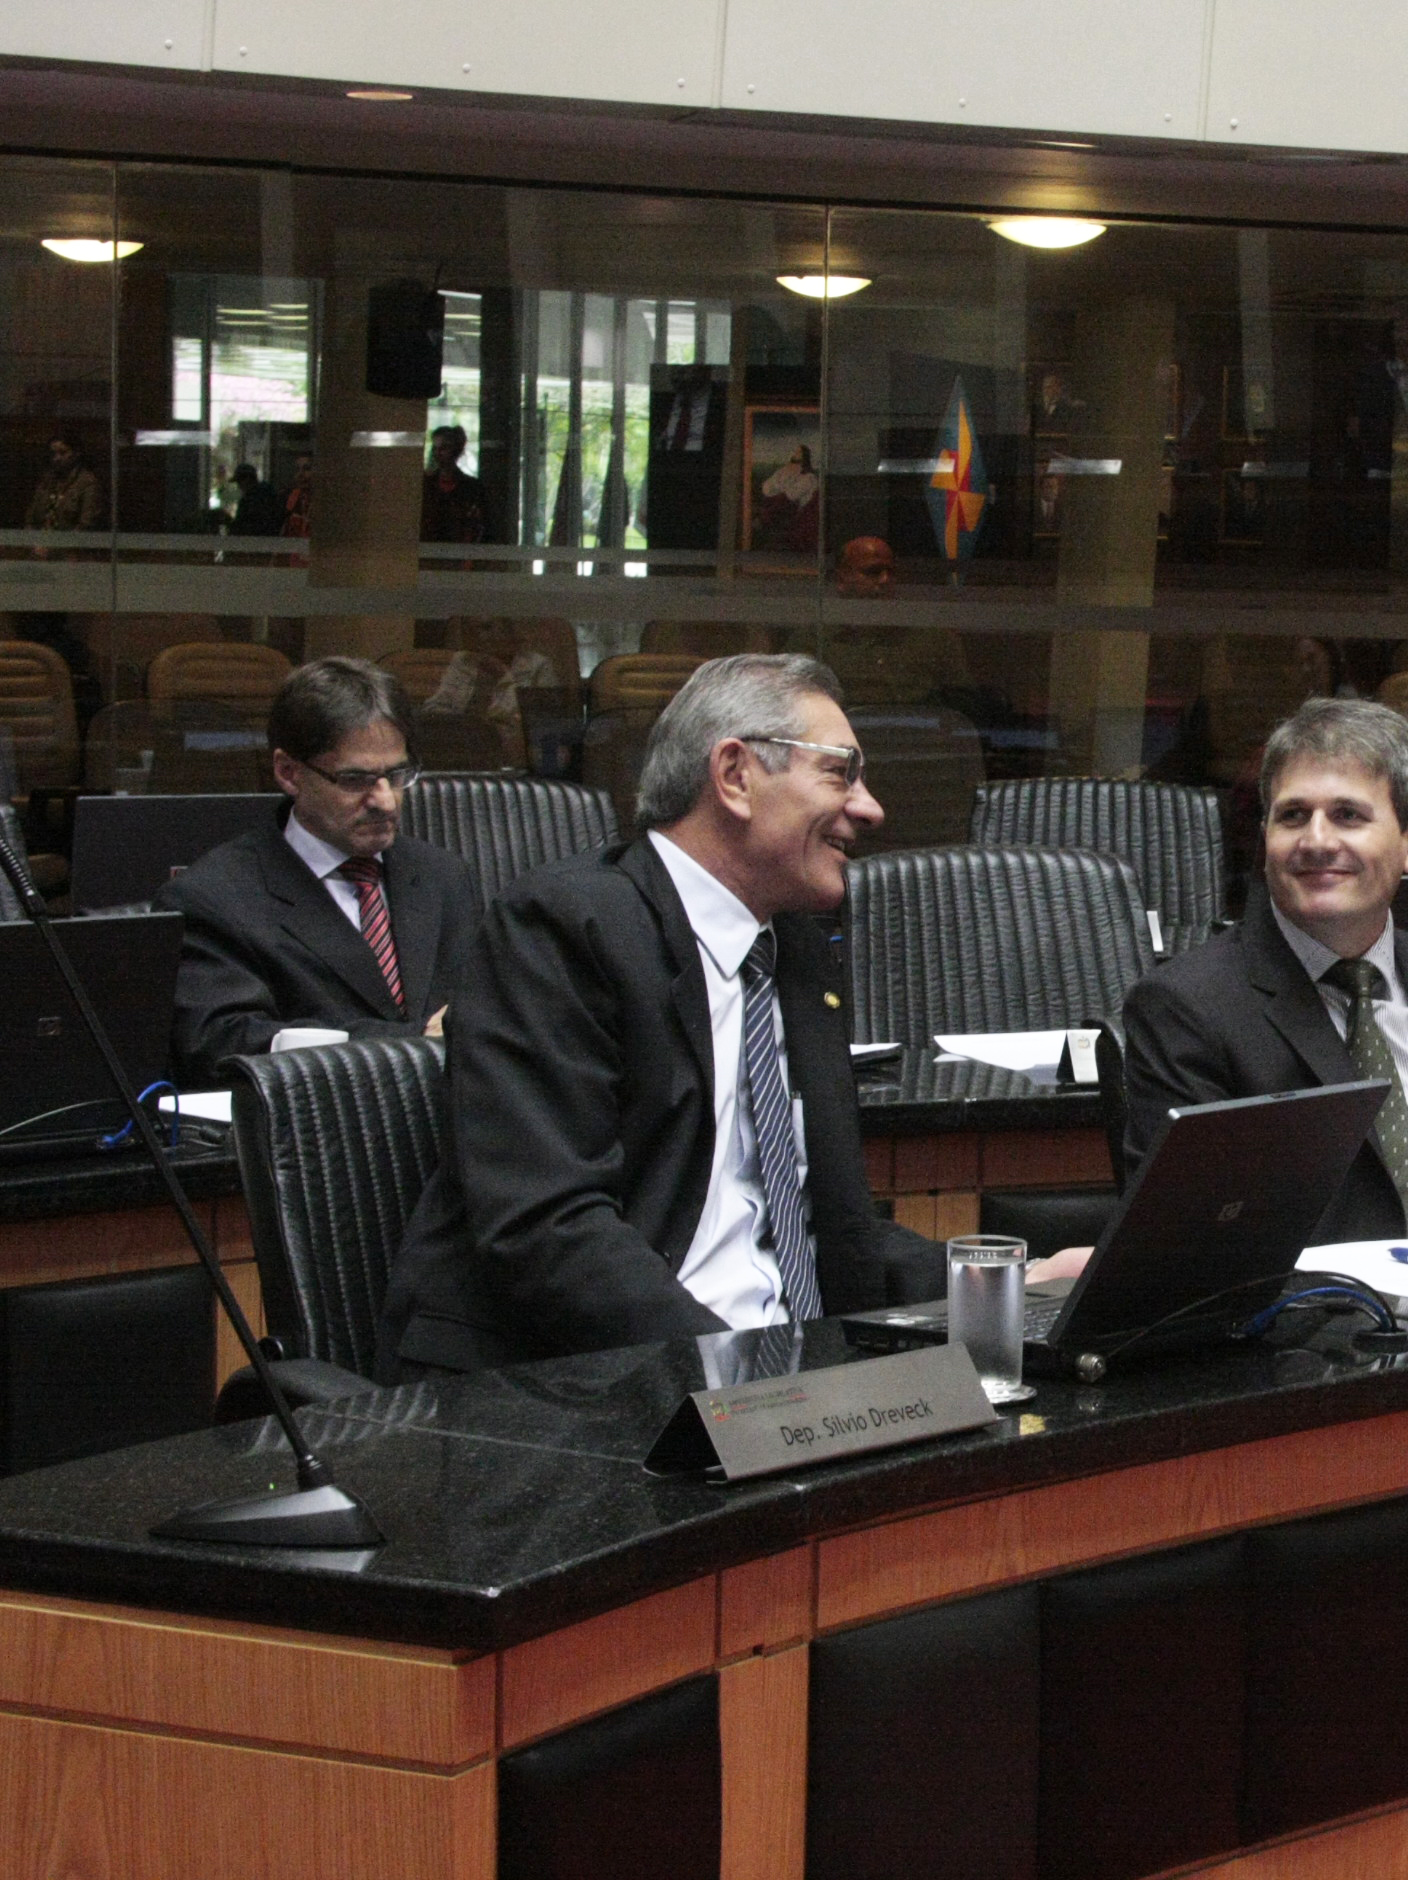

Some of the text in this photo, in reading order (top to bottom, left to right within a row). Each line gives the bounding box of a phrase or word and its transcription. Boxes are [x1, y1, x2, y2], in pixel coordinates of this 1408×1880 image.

[780, 1398, 935, 1447] Dep. Silvio Dreveck
